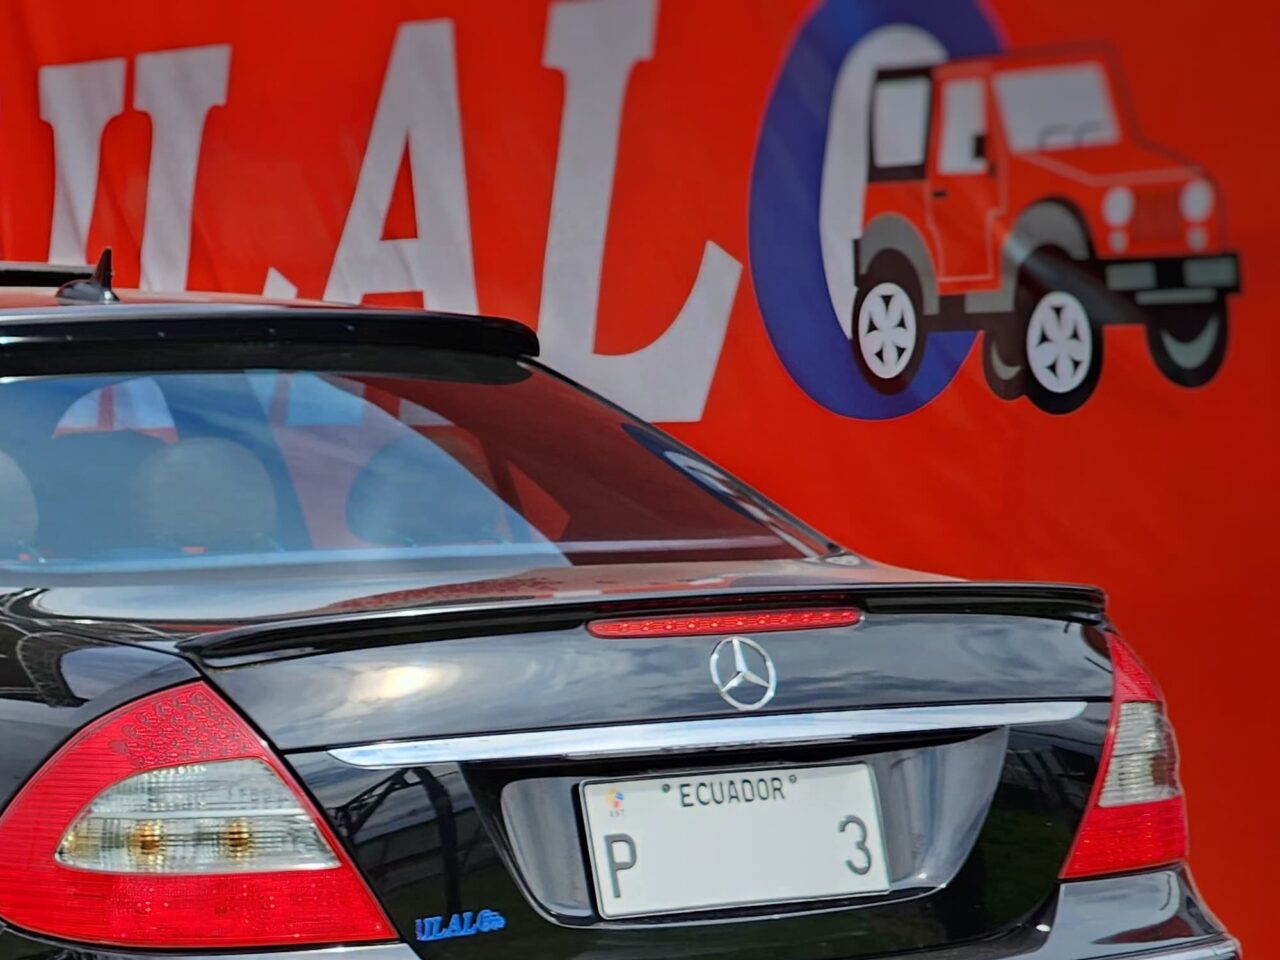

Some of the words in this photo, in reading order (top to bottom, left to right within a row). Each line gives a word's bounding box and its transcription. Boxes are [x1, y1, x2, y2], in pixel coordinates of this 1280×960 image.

[679, 777, 785, 807] ECUADOR
[603, 833, 637, 899] P
[838, 814, 872, 875] 3
